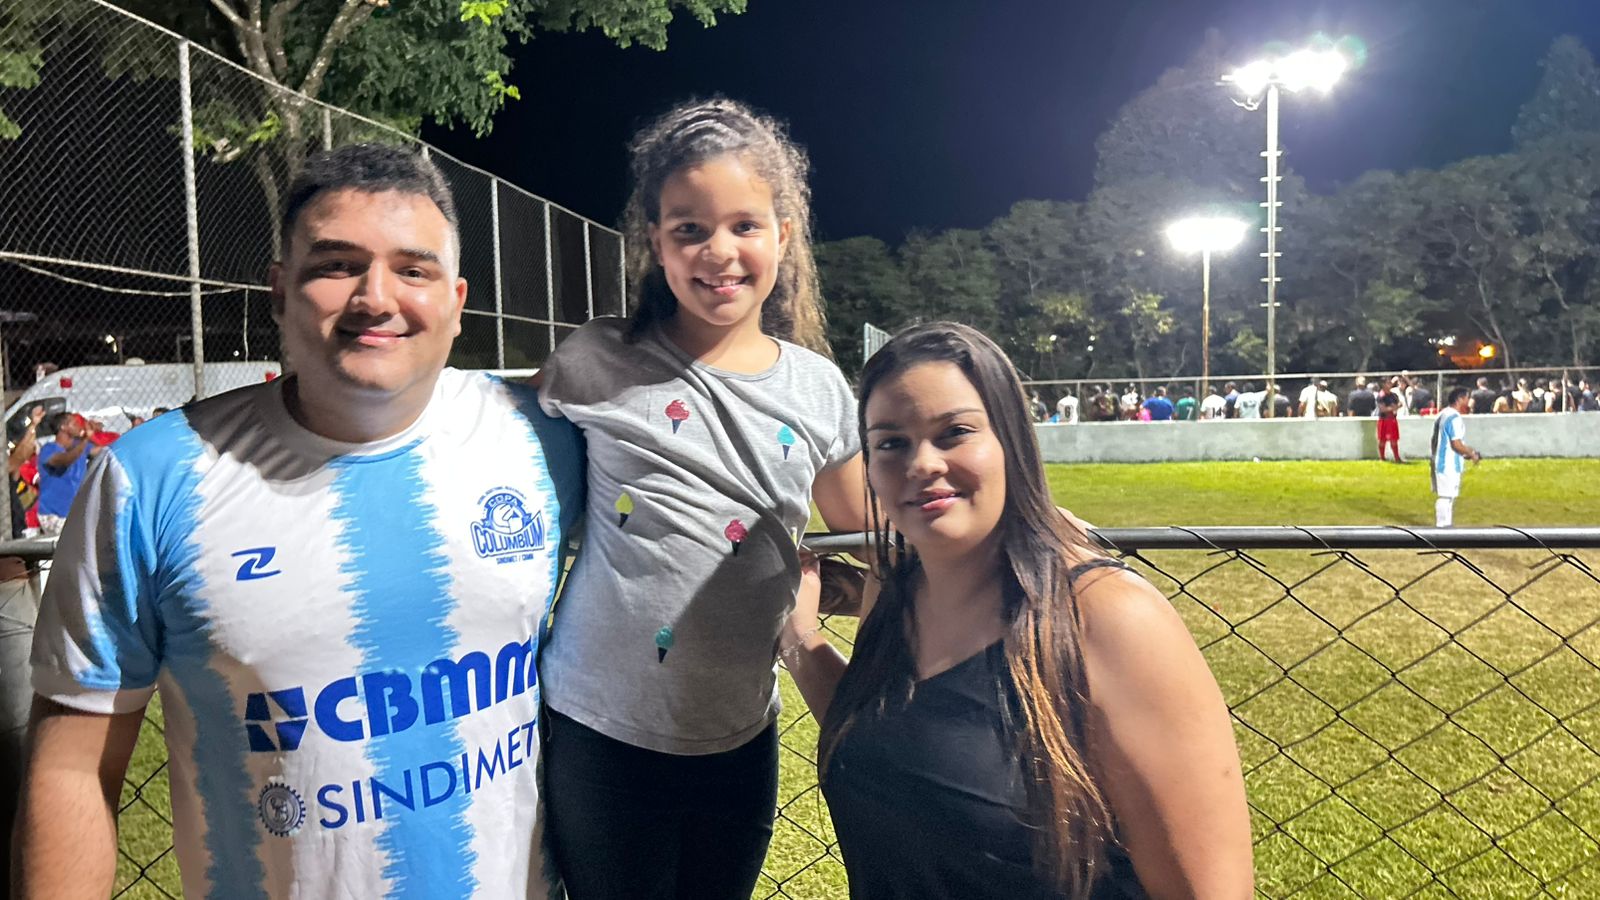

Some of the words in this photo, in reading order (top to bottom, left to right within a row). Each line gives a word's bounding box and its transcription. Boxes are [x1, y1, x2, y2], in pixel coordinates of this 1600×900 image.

[1186, 406, 1194, 420] 7
[488, 495, 518, 508] COPA
[474, 517, 542, 554] COLUMBIUM
[316, 718, 536, 829] SINDIMET
